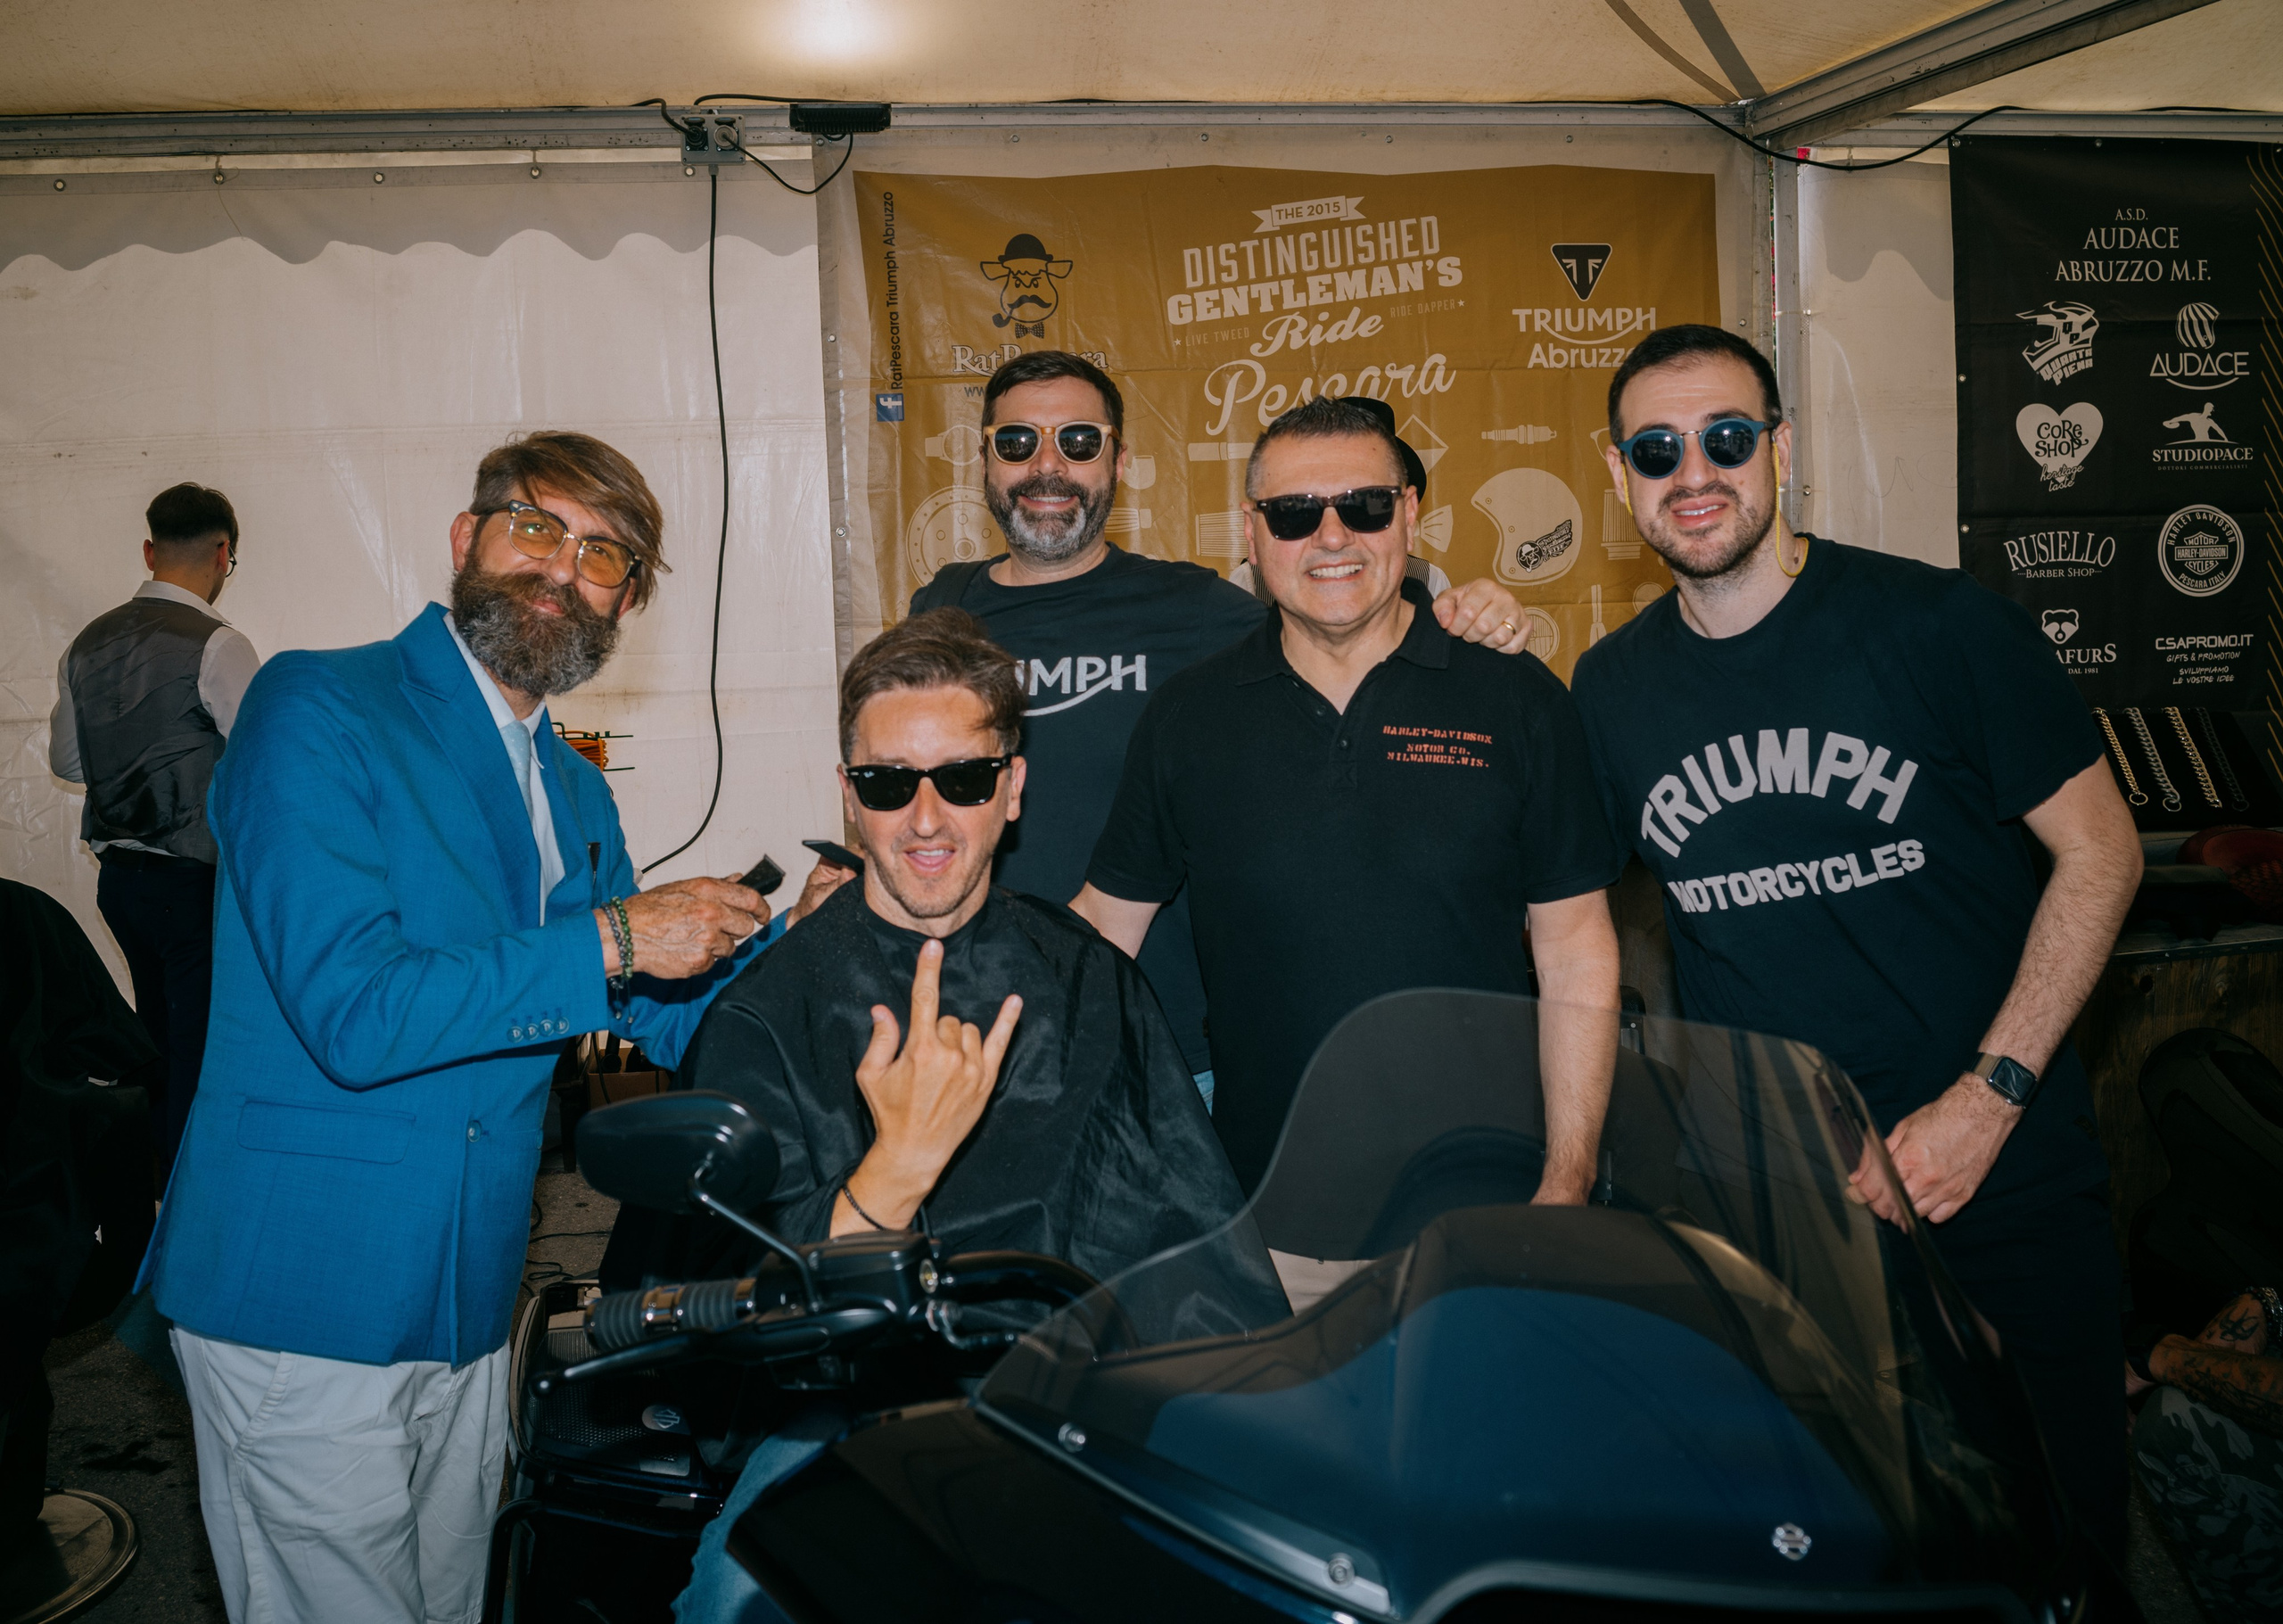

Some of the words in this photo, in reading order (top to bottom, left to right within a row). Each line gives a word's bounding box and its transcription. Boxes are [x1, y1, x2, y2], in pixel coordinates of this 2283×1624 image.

[883, 191, 894, 246] Abruzzo
[1275, 205, 1303, 220] THE
[1306, 202, 1340, 217] 2015
[2114, 208, 2148, 221] A.S.D.
[2083, 227, 2180, 250] AUDACE
[1183, 215, 1440, 288] DISTINGUISHED
[884, 251, 899, 307] Triumph
[2055, 260, 2163, 282] ABRUZZO
[2170, 260, 2212, 281] M.F.
[1166, 256, 1463, 326] GENTLEMAN'S
[1390, 304, 1413, 317] RIDE
[1417, 299, 1455, 315] DAPPER
[1249, 306, 1384, 357] Ride
[1512, 307, 1656, 344] TRIUMPH
[1185, 332, 1209, 347] LIVE
[1214, 326, 1249, 342] TWEED
[889, 311, 903, 390] RatPescara
[1527, 342, 1635, 368] Abruzz
[2053, 359, 2093, 385] PIENA
[2150, 352, 2250, 376] AUDACE
[2034, 437, 2082, 458] SHOP
[2152, 447, 2254, 462] STUDIOPACE
[2040, 464, 2085, 482] heritage
[2048, 475, 2075, 492] taste
[2167, 514, 2192, 546] HARLEY
[2195, 512, 2237, 543] DAVIDSON
[2188, 535, 2215, 546] MOTOR
[2003, 531, 2116, 572] RUSIELLO
[2177, 547, 2227, 559] HARLEY-DAVIDSON
[2188, 559, 2215, 573] CYCLES
[2178, 573, 2209, 589] PESCARA
[2207, 571, 2227, 587] ITALY
[2155, 633, 2254, 651] CSAPROMO.IT
[2166, 653, 2189, 663] GIFTS
[2190, 653, 2196, 662] &
[2197, 651, 2241, 662] PROMOTION
[2172, 677, 2184, 685] LE
[2186, 676, 2213, 684] VOSTRE
[2179, 665, 2229, 675] SVILUPPIAMO
[1382, 725, 1493, 745] HARLEY-DAVIDSON
[1449, 746, 1471, 755] CO.
[1641, 728, 1919, 858] TRIUMPH
[1667, 839, 1925, 913] MOTORCYCLES
